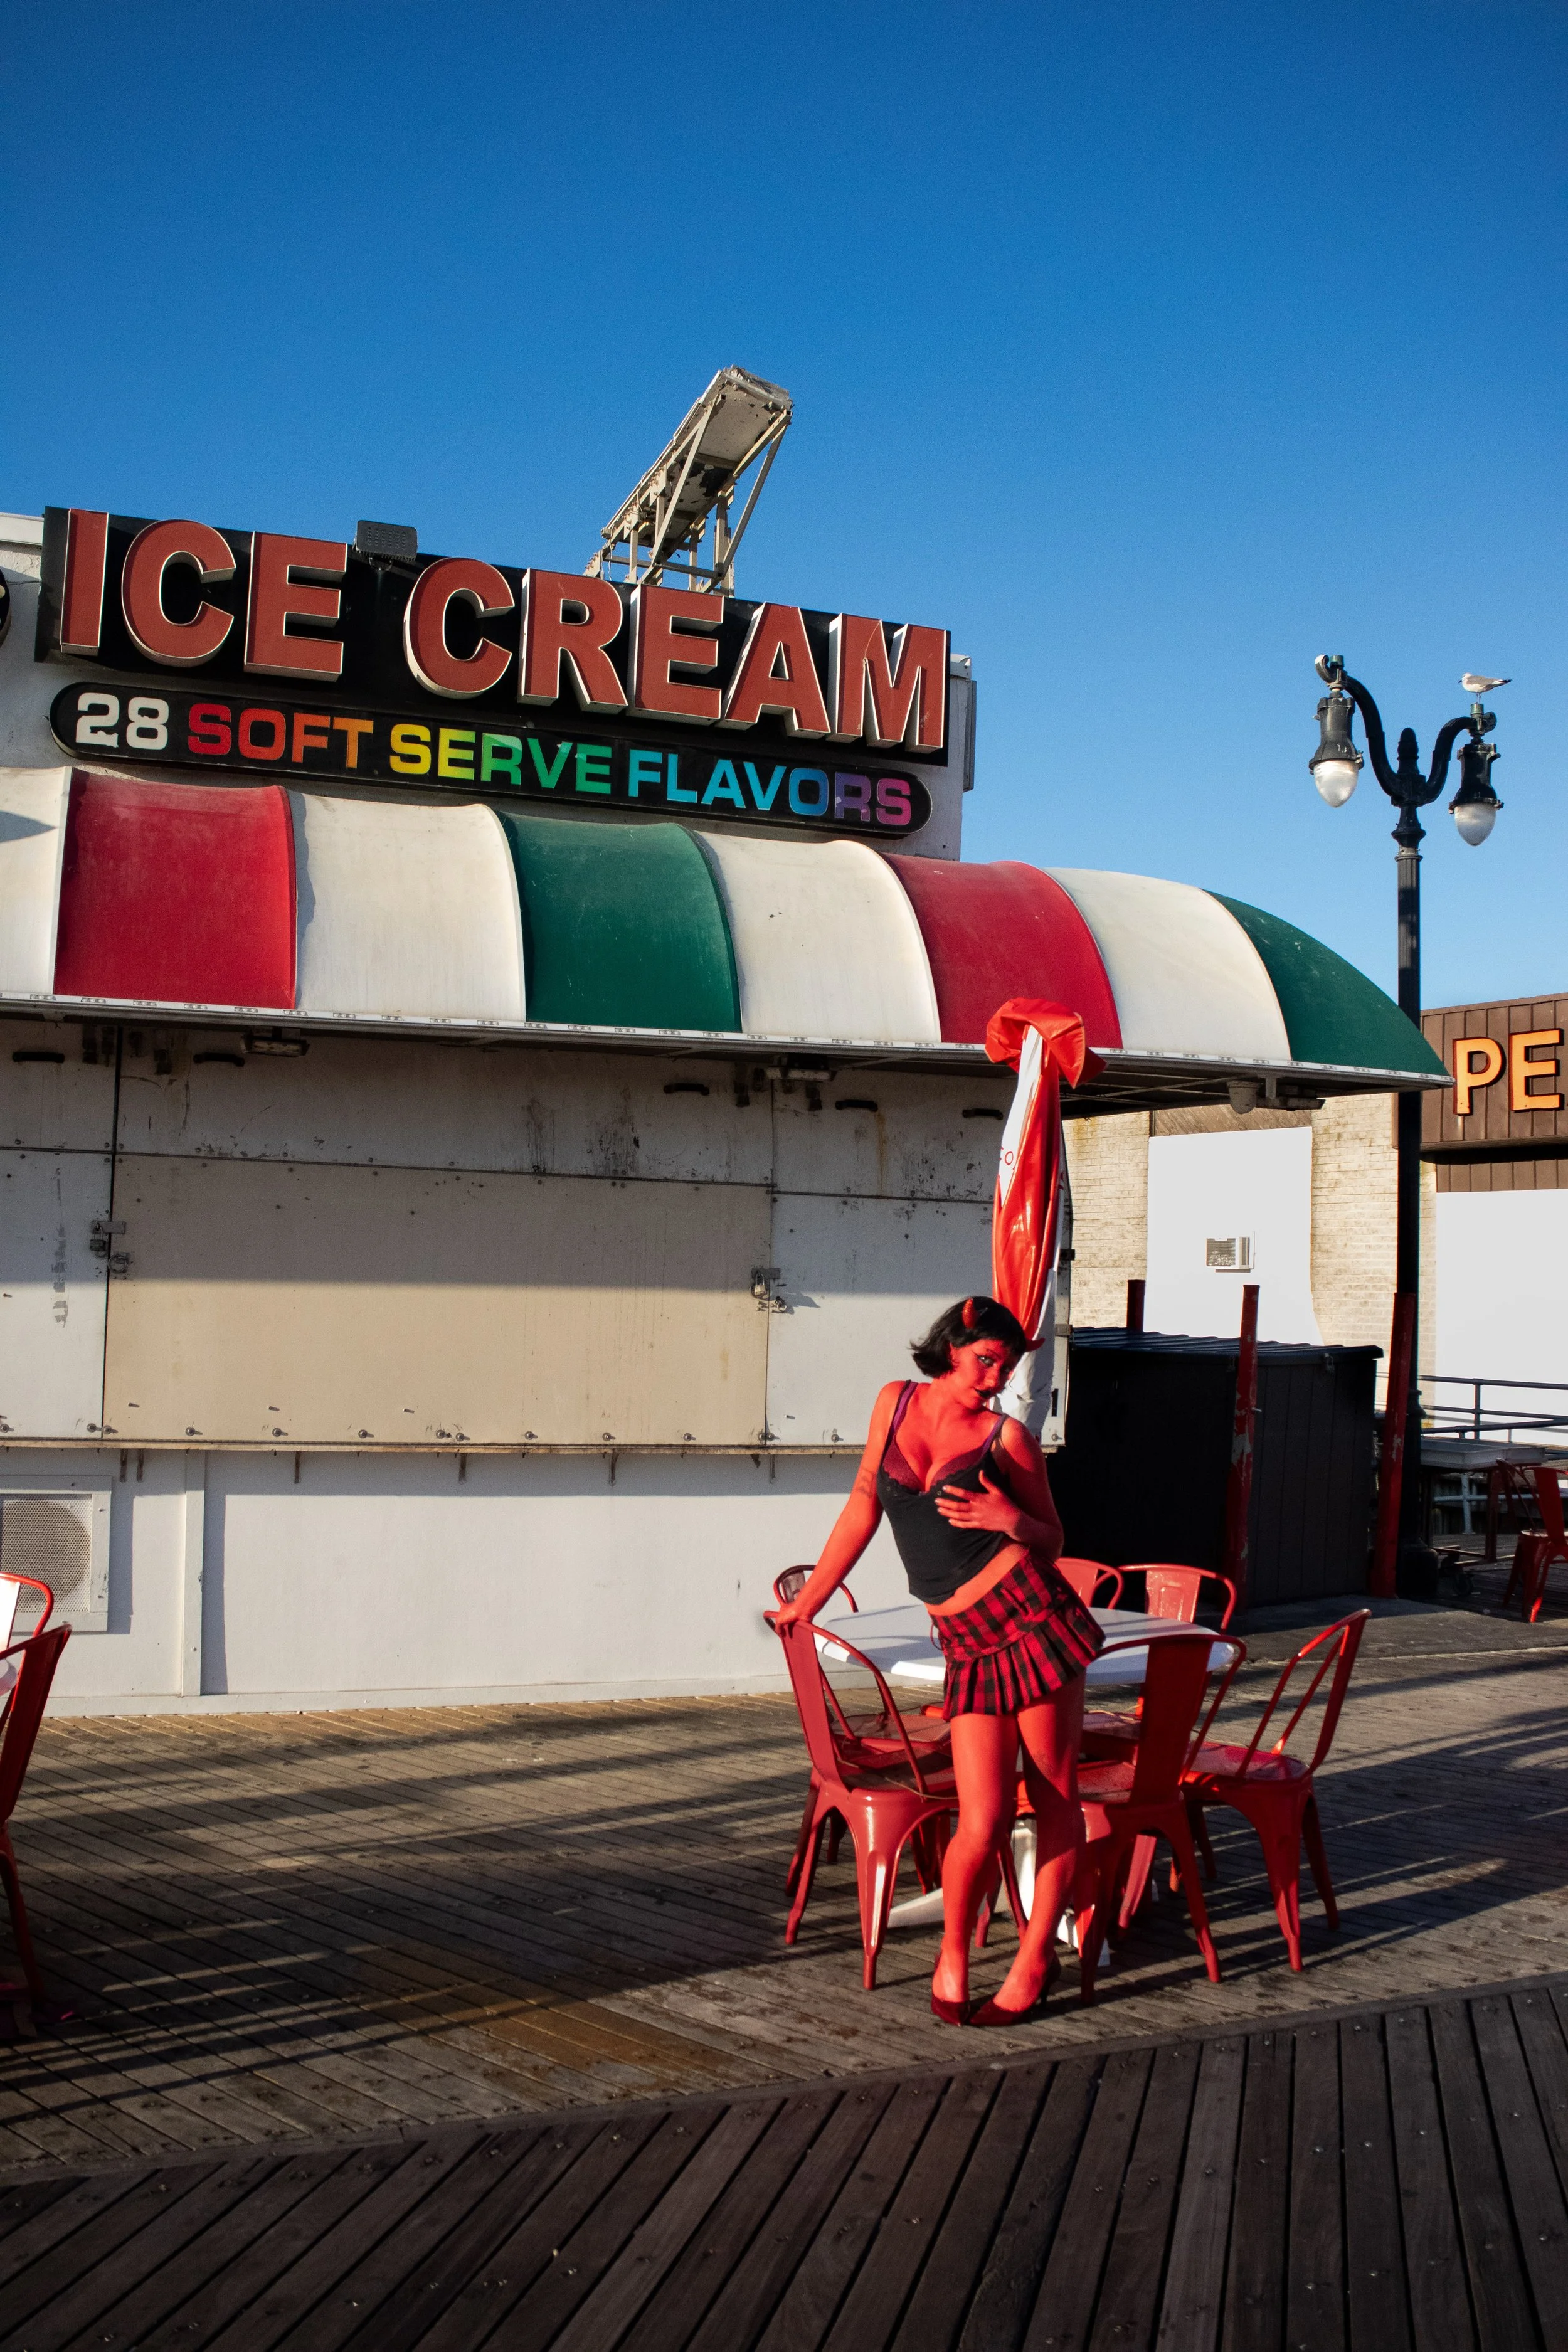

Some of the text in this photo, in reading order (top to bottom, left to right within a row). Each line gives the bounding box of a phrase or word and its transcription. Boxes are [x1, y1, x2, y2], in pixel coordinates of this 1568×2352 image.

[60, 507, 947, 753] ICE CREAM
[75, 692, 912, 826] 28 SOFT SERVE FLAVORS
[1453, 1028, 1563, 1116] PE
